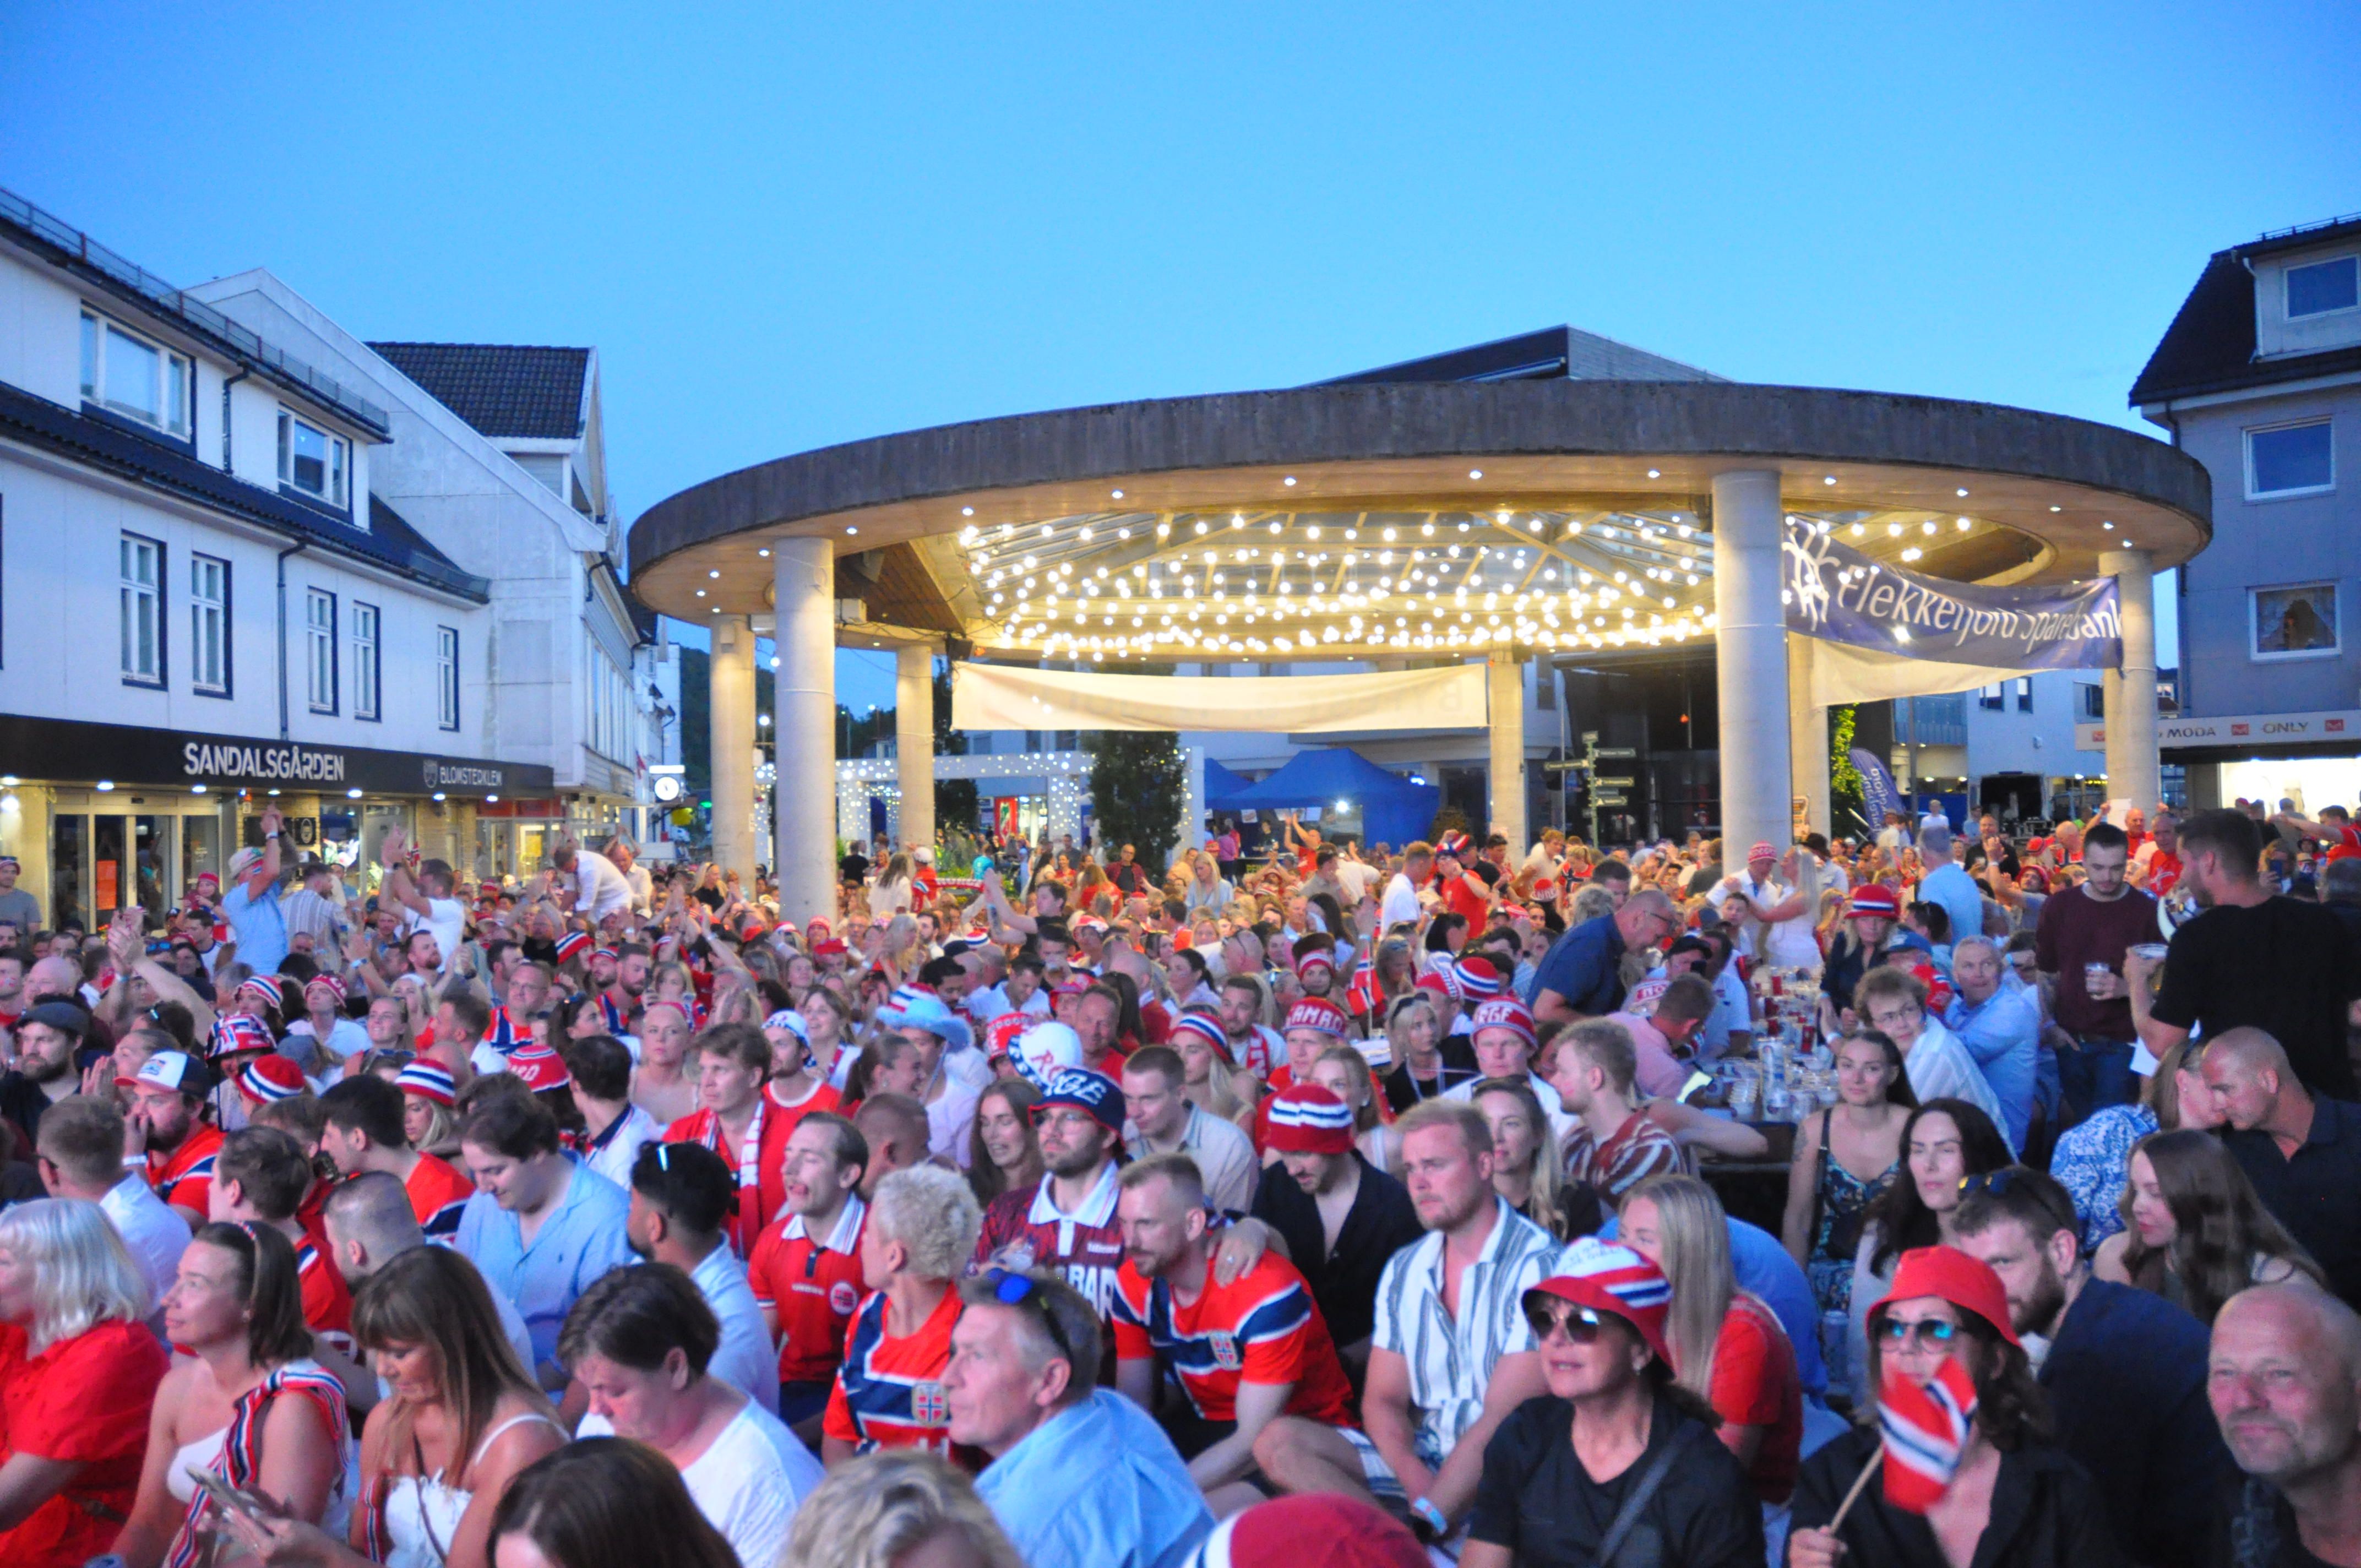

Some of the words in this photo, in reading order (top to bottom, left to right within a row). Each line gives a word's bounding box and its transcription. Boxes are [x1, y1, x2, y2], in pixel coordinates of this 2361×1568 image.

[2167, 727, 2216, 738] MODA
[2262, 722, 2308, 734] ONLY
[183, 743, 344, 781] SANDALSGÅRDEN
